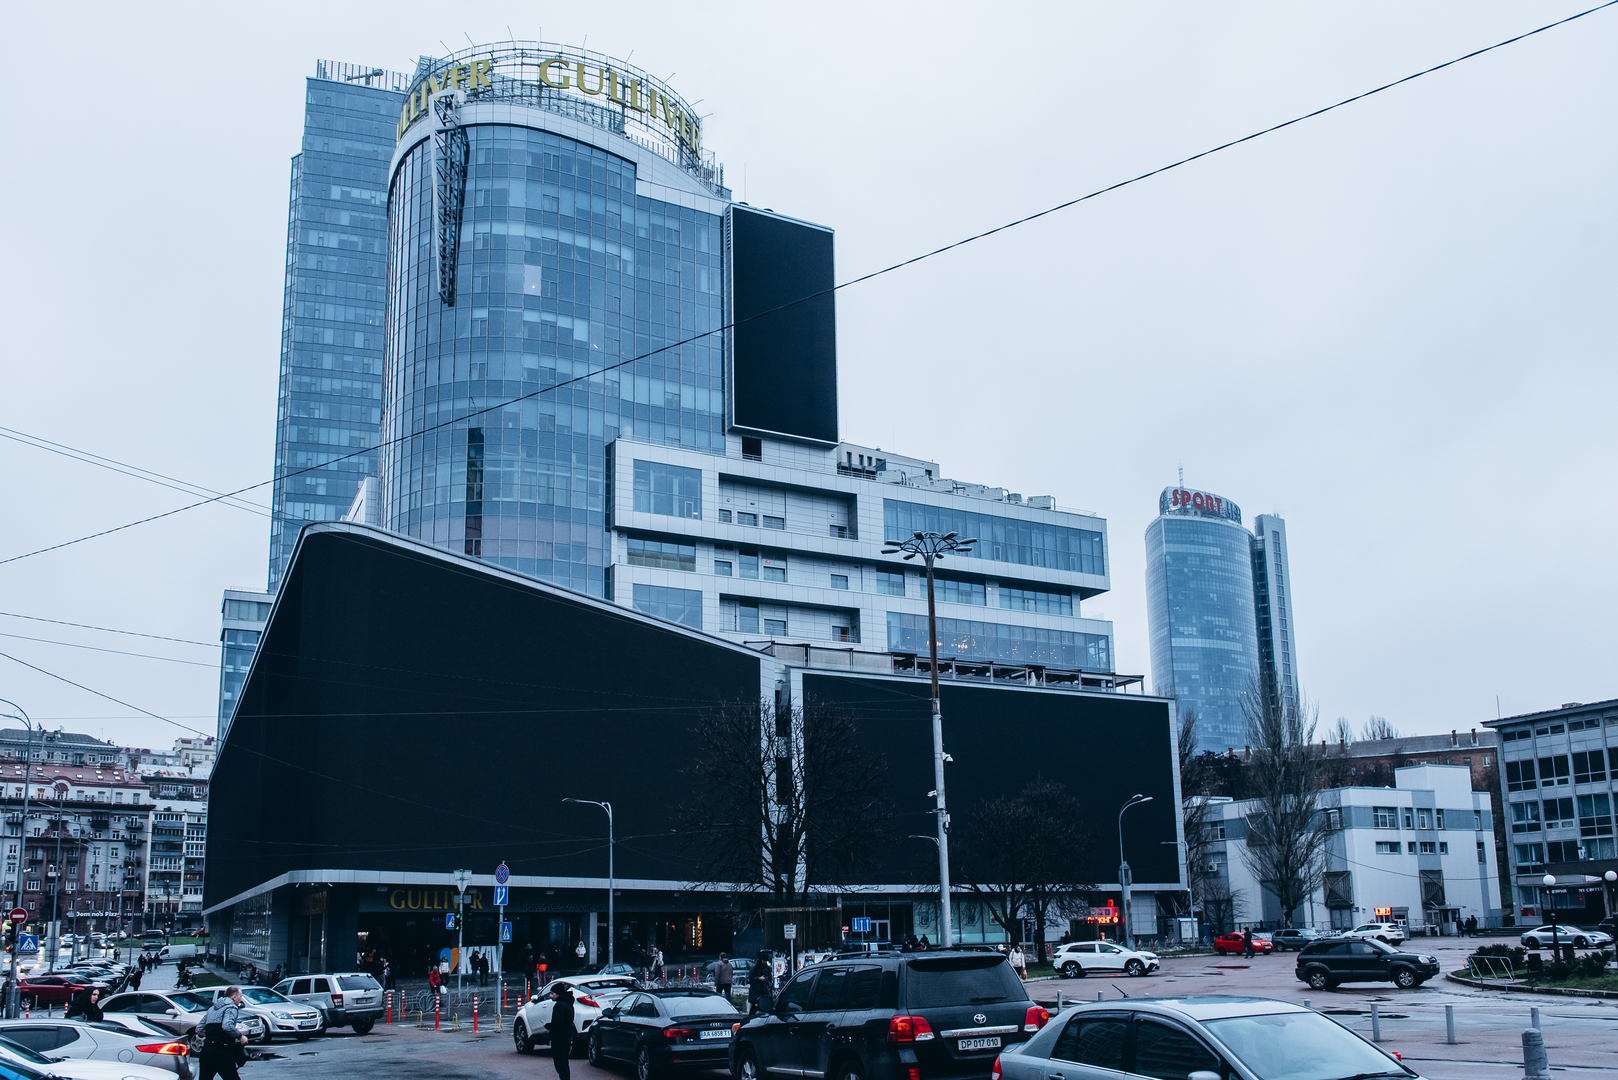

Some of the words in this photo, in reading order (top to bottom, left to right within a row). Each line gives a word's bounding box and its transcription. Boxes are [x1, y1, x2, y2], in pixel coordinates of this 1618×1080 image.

[396, 59, 493, 142] LLIVER
[538, 57, 702, 160] GULLIVER
[1172, 488, 1222, 515] SPORT
[389, 889, 483, 909] GULLIVR
[1087, 916, 1112, 924] ПКІНГ
[961, 1040, 972, 1049] DP
[973, 1039, 985, 1048] 017
[986, 1038, 999, 1047] 010
